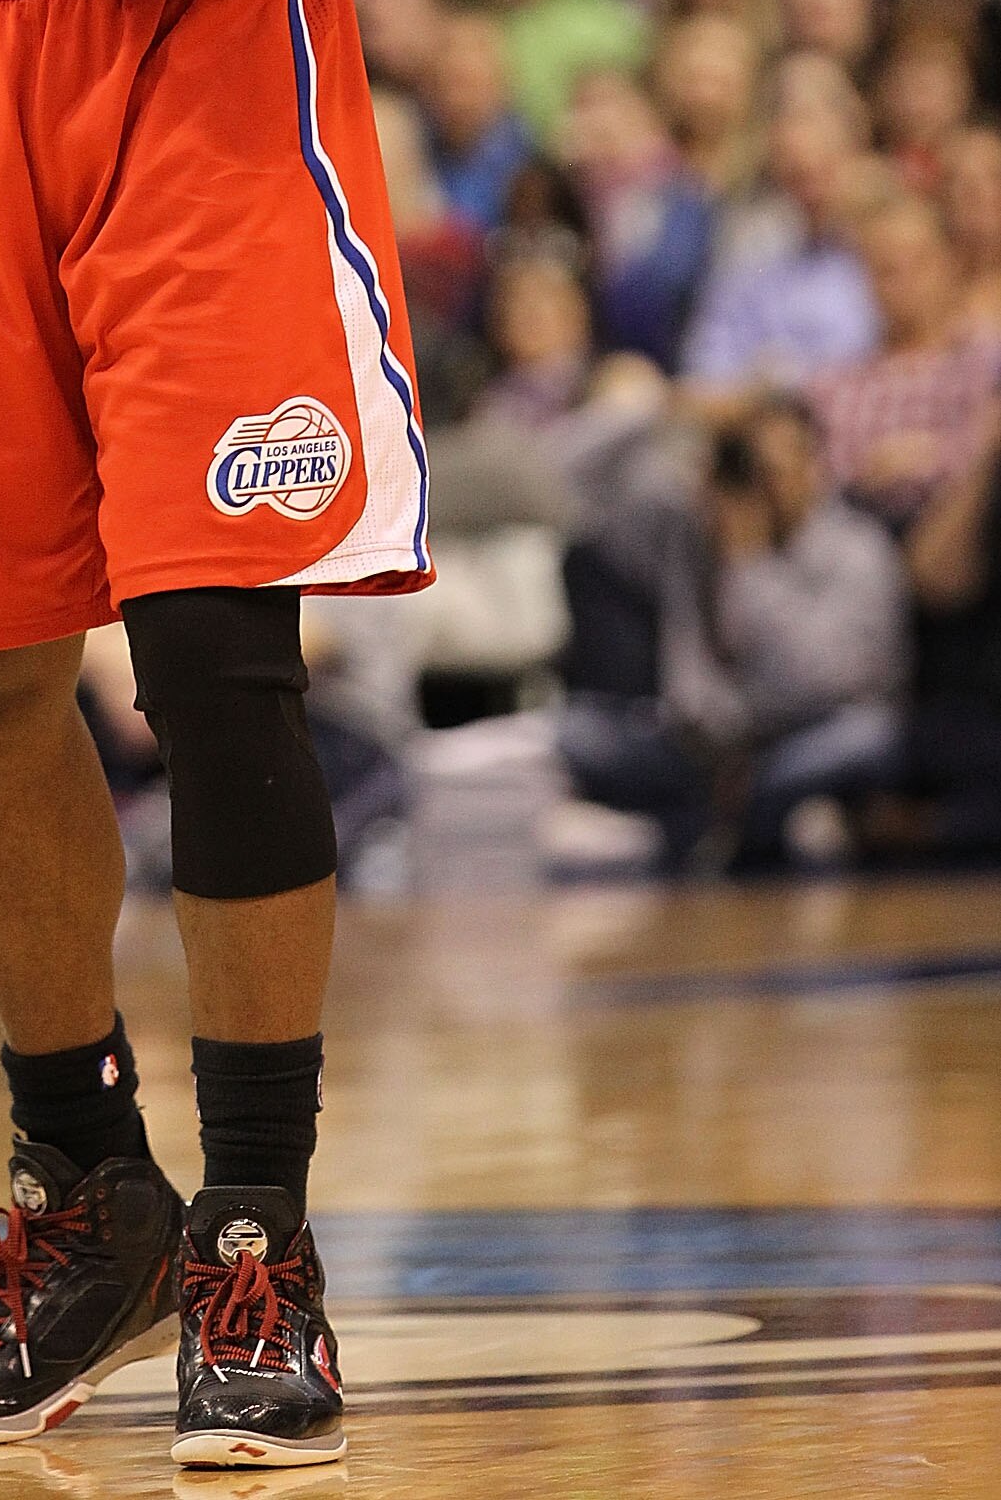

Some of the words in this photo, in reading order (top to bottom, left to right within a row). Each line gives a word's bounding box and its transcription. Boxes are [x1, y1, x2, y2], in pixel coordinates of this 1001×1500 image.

[266, 445, 288, 458] LOS
[290, 440, 337, 455] ANGELES
[215, 446, 337, 508] CLIPPERS
